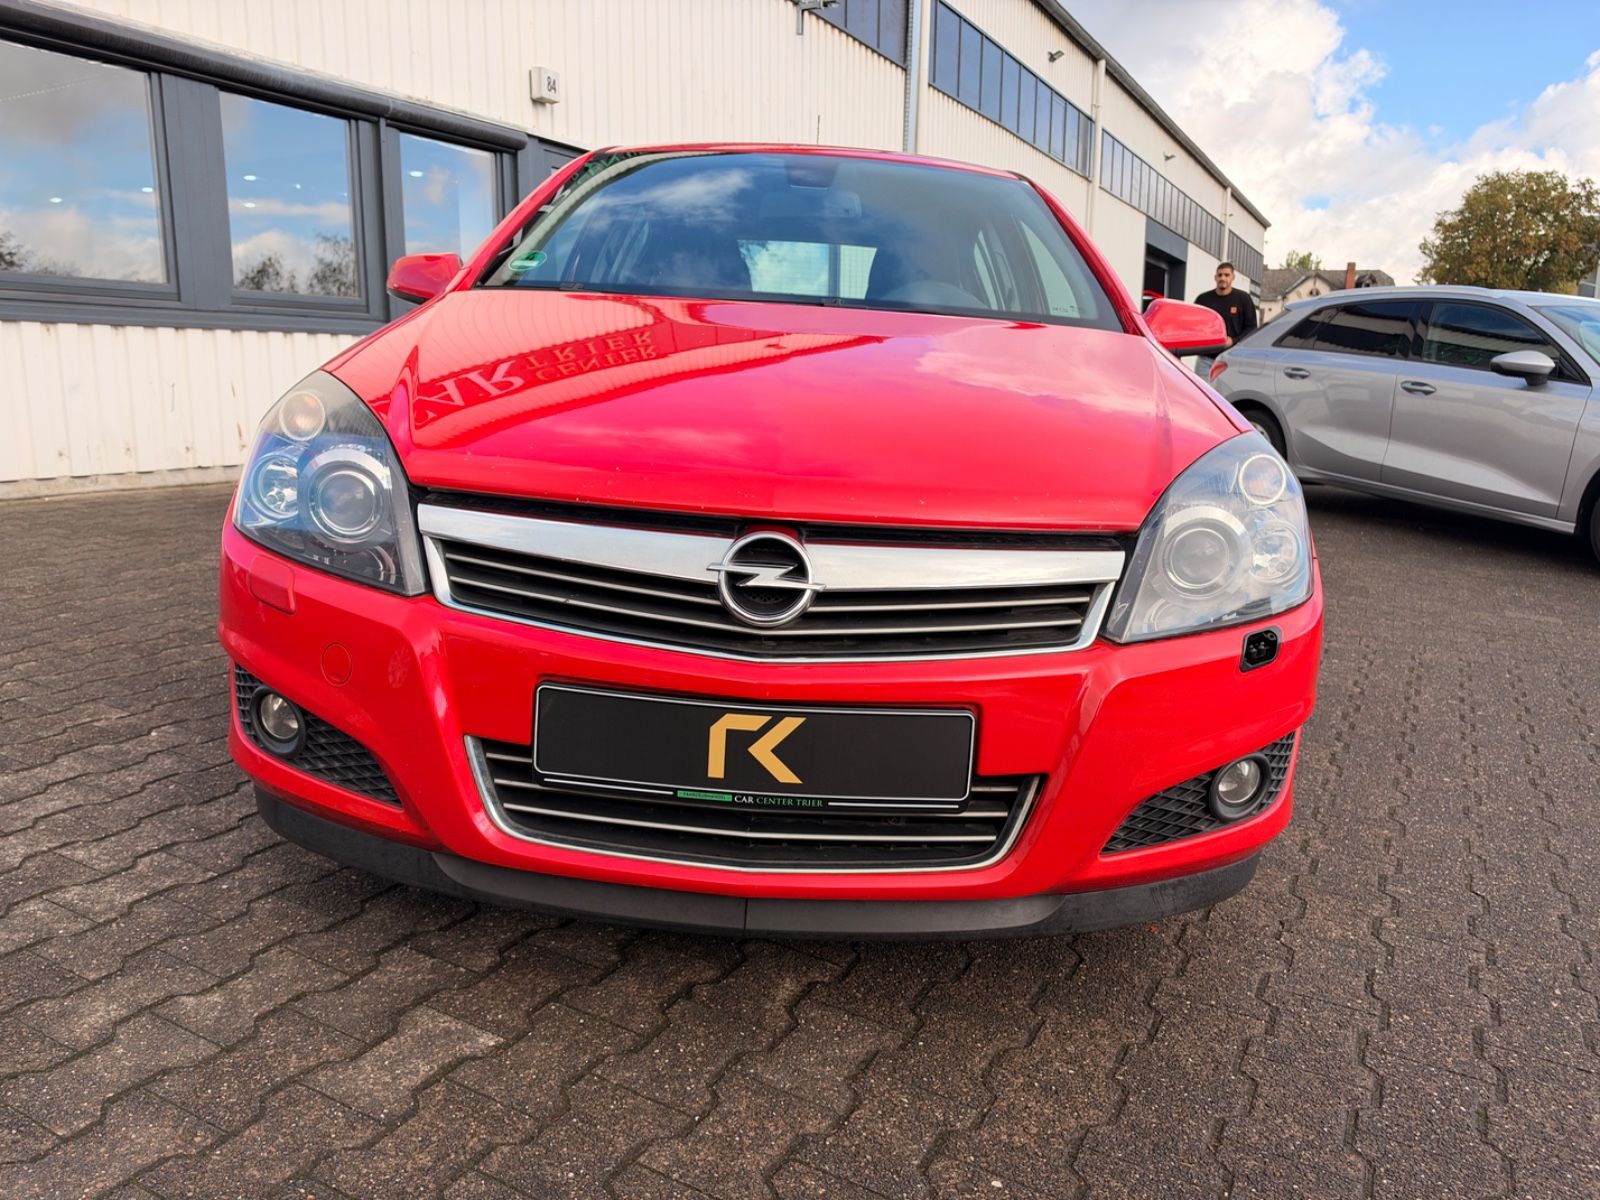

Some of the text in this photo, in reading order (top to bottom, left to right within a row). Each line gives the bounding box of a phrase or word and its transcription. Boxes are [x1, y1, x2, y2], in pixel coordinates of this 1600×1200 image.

[546, 76, 557, 94] 84
[734, 795, 754, 804] CAR
[756, 796, 794, 806] CENTER
[796, 799, 824, 808] TRIER
